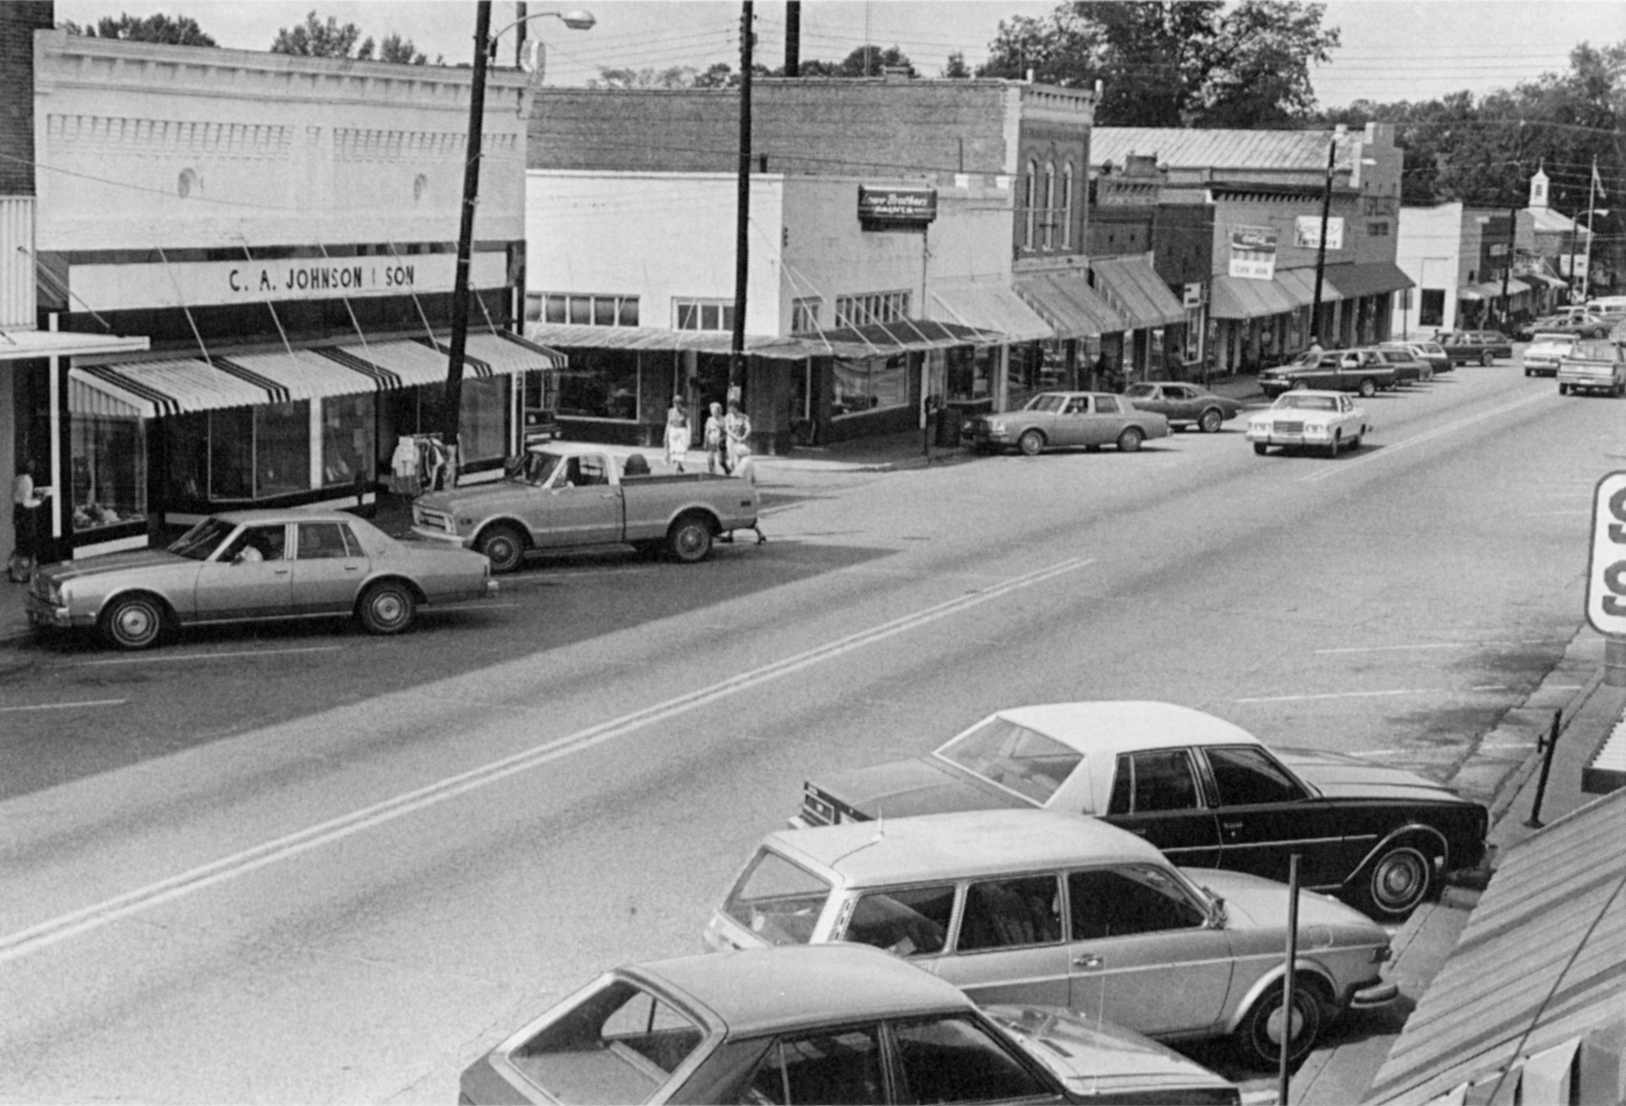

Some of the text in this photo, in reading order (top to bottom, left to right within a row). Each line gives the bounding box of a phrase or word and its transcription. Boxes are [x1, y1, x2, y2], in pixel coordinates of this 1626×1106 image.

[229, 269, 249, 292] C.
[259, 269, 276, 292] A.
[286, 267, 362, 290] JOHNSON
[386, 265, 414, 287] SON
